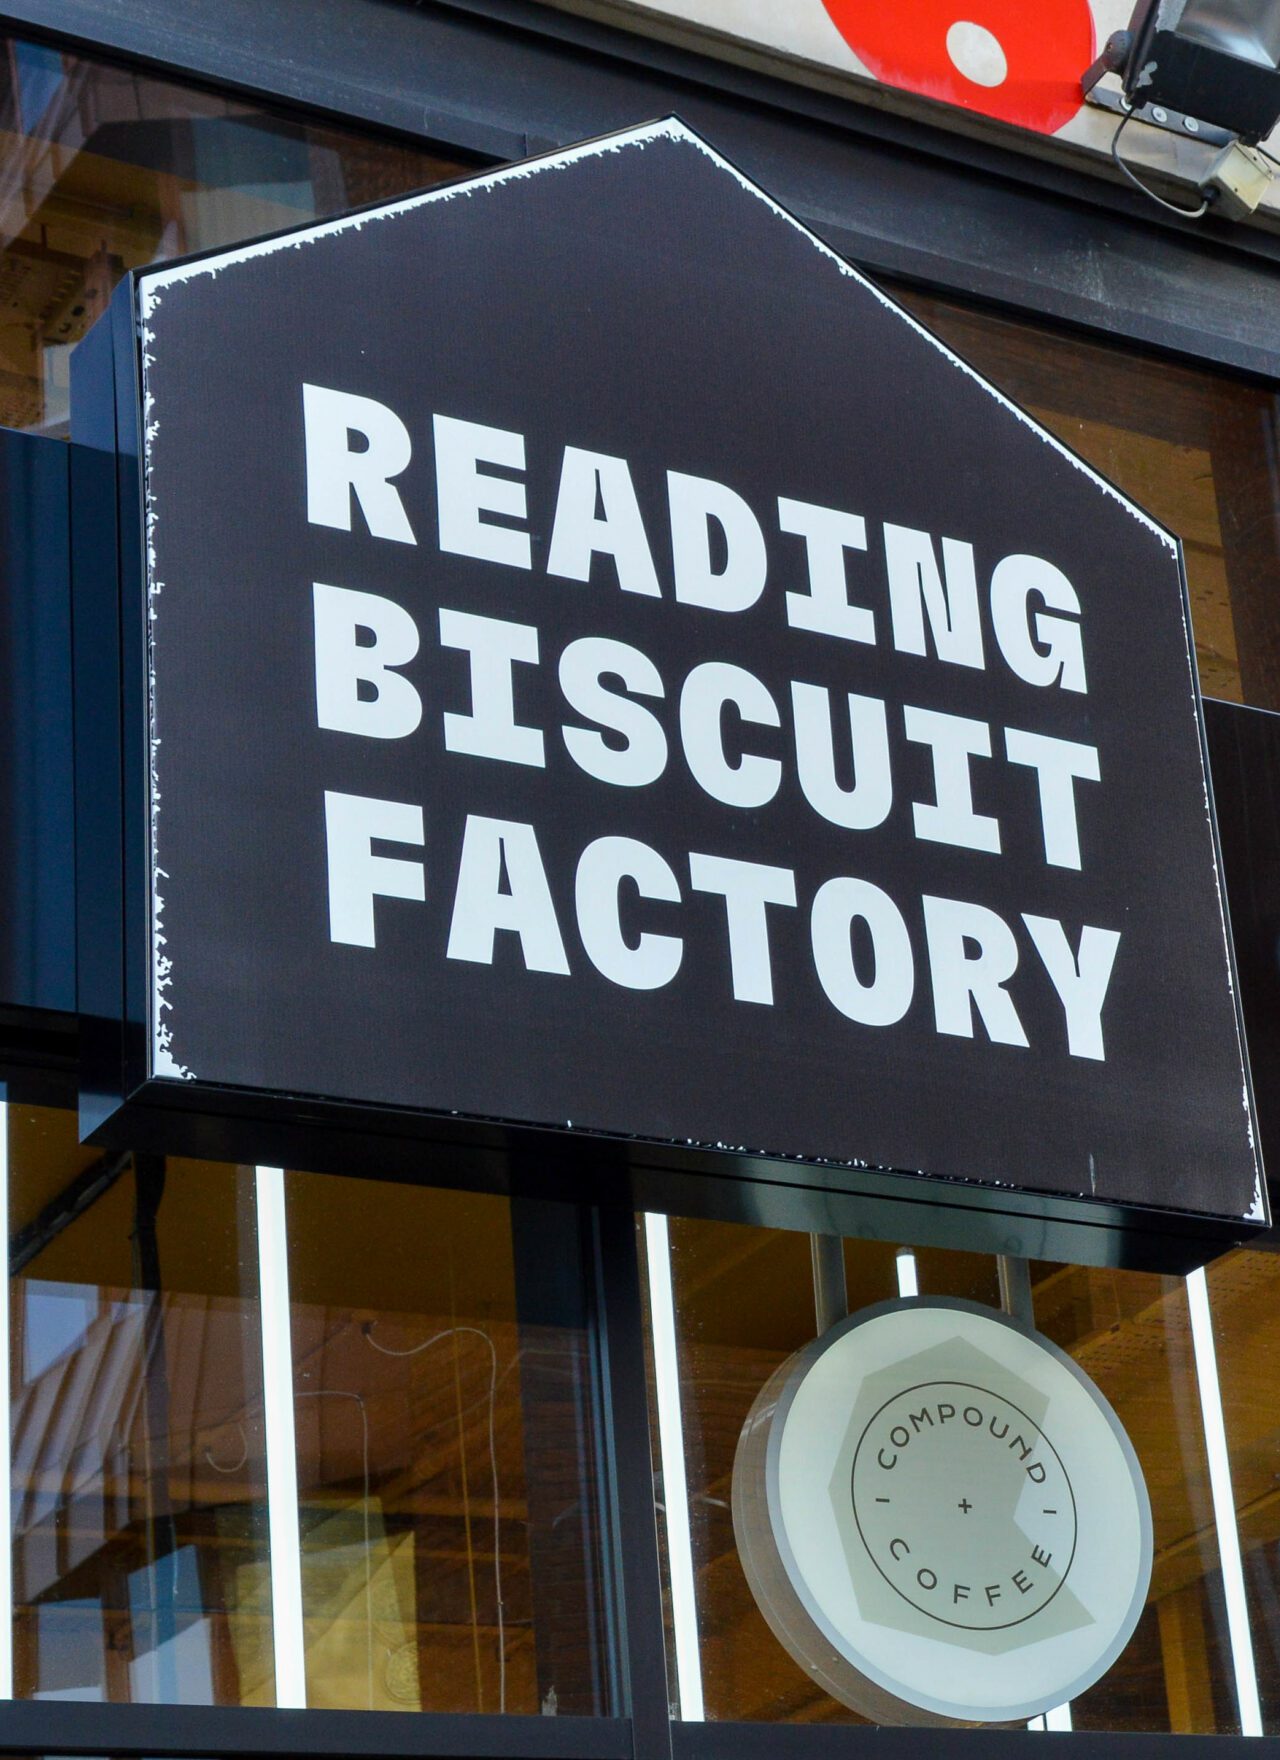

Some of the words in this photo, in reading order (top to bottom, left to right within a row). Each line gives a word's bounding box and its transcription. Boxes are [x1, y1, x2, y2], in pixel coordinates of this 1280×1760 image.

[302, 383, 1088, 694] READING
[312, 582, 1101, 871] BISCUIT
[324, 790, 1121, 1062] FACTORY
[877, 1403, 1047, 1484] COMPOUND
[889, 1537, 1053, 1607] COFFEE
